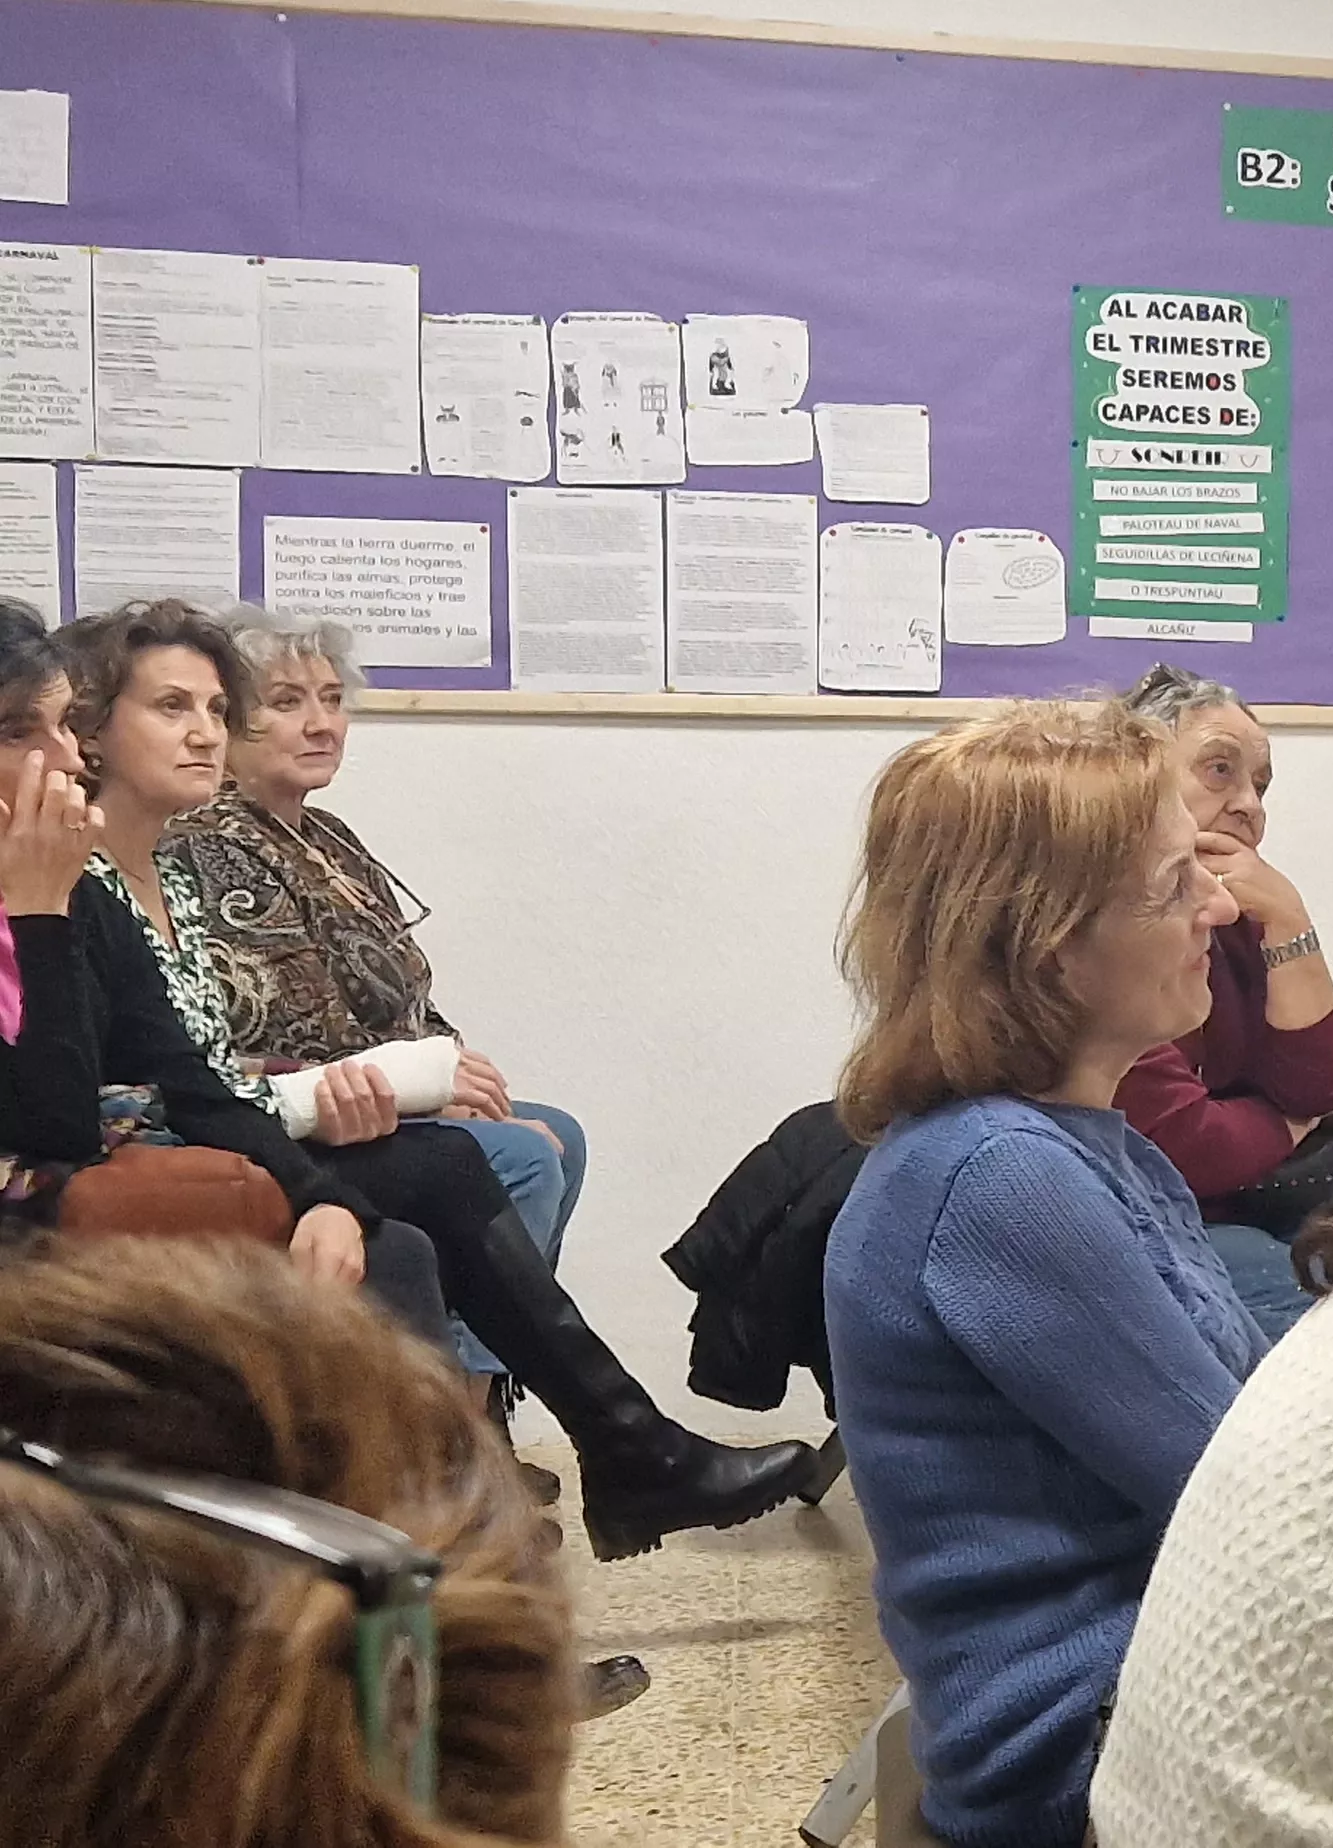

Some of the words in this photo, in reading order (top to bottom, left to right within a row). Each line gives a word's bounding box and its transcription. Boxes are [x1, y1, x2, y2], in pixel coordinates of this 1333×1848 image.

[1240, 152, 1298, 185] B2:
[0, 250, 60, 260] ARNAVAL
[1107, 299, 1138, 319] AL
[1146, 301, 1243, 323] ACABAR
[1093, 333, 1121, 352] EL
[1129, 334, 1267, 359] TRIMESTRE
[1122, 368, 1236, 392] SEREMOS
[1102, 403, 1211, 425] CAPACES
[1219, 407, 1257, 427] DE:
[1110, 486, 1129, 496] NO
[1132, 486, 1168, 497] BAJAR
[1171, 487, 1193, 498] LOS
[1196, 487, 1241, 499] BRAZOS
[1122, 519, 1184, 530] PALOTEAU
[1186, 519, 1201, 529] DE
[1204, 518, 1242, 529] NAVAL
[274, 534, 337, 547] Mientras
[342, 538, 354, 548] la
[463, 543, 476, 552] el
[275, 552, 316, 567] fuego
[320, 554, 376, 565] calienta
[380, 556, 401, 567] los
[405, 556, 467, 570] hogares,
[1102, 548, 1176, 561] SEGUIDILLAS
[1179, 550, 1195, 561] DE
[1198, 549, 1254, 563] LECIÑENA
[275, 569, 328, 582] purifica
[332, 570, 352, 582] las
[409, 575, 463, 588] protege
[275, 587, 320, 598] contra
[325, 587, 345, 598] los
[350, 588, 421, 601] maleficios
[438, 592, 466, 602] trae
[1145, 586, 1224, 599] TRESPUNTIAU
[366, 606, 406, 617] sobre
[411, 606, 432, 617] las
[377, 624, 441, 636] animales
[457, 625, 478, 636] las
[1147, 622, 1196, 636] ALCAÑIZ
